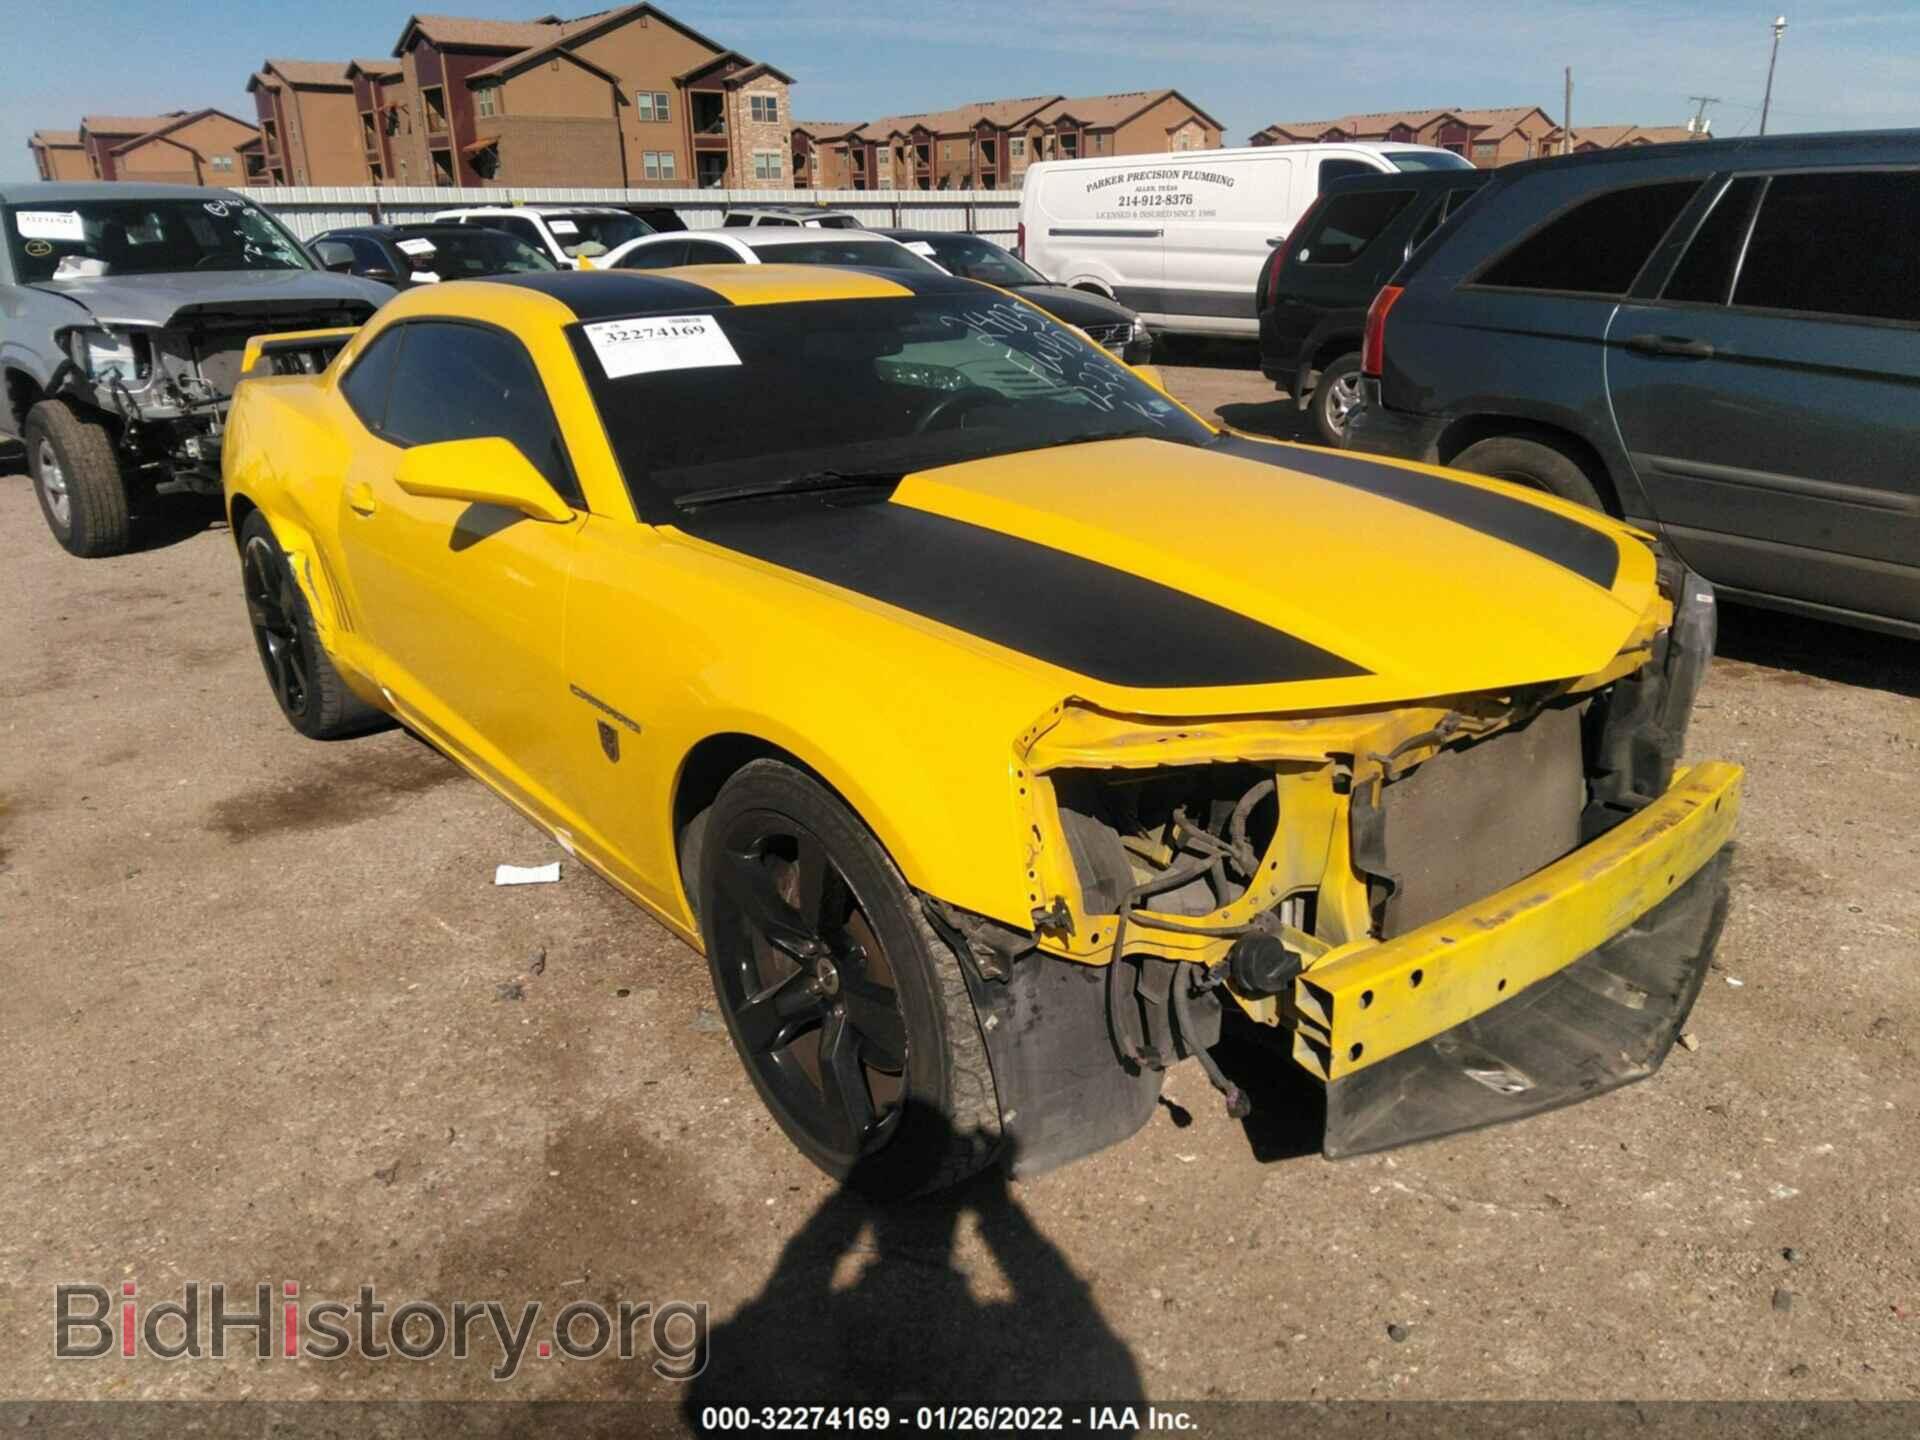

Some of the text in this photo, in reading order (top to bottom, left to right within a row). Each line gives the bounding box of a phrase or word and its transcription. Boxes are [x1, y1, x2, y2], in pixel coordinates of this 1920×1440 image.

[1086, 169, 1235, 193] PARKER PRECISION PLUMBING
[1118, 193, 1193, 207] 214-912-8376
[606, 325, 705, 343] 32274169
